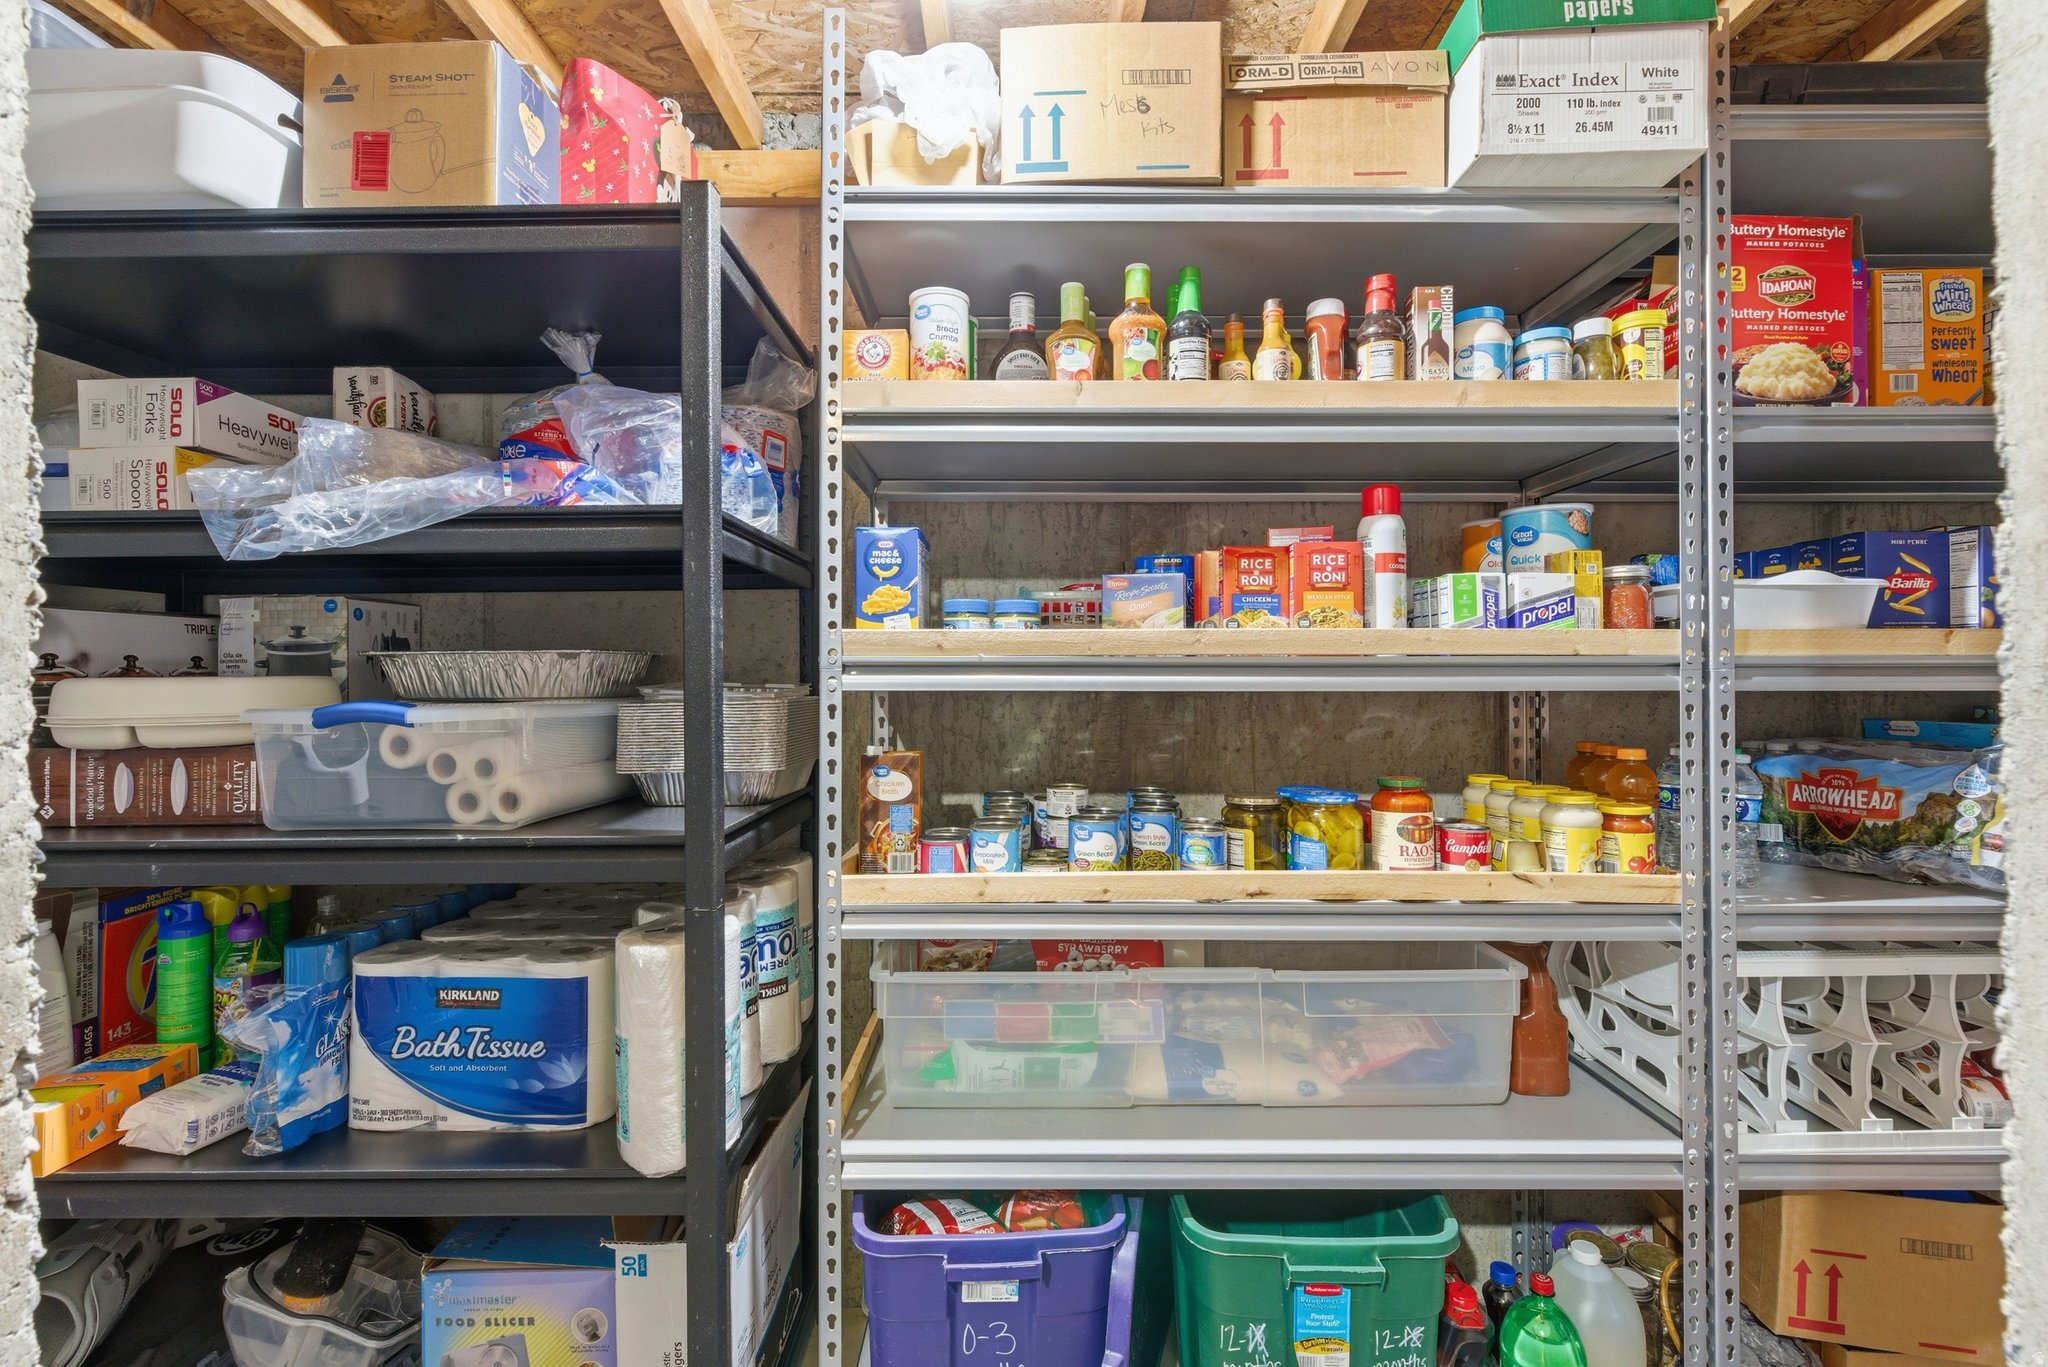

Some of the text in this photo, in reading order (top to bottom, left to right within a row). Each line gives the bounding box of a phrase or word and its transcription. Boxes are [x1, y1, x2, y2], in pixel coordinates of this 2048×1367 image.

[1563, 0, 1634, 22] papers
[1235, 67, 1290, 78] ORM-D
[1303, 65, 1358, 76] ORM-D-AIR
[1641, 67, 1680, 79] White
[389, 73, 432, 83] STEAM
[1572, 72, 1619, 87] Index
[1516, 97, 1541, 108] 2000
[1566, 97, 1621, 109] 110 lb. Index
[1141, 117, 1175, 138] Kits
[1533, 123, 1545, 136] 11
[1575, 121, 1614, 134] 26.45M
[1641, 125, 1679, 136] 49411
[1777, 223, 1848, 240] Homestyle
[1746, 240, 1825, 249] MASHED POTATOES
[1731, 267, 1742, 282] 2
[1761, 279, 1813, 294] IDAHOAN
[1937, 289, 1969, 302] Mini
[1933, 300, 1972, 313] Wheats
[1776, 308, 1848, 323] Homestyle
[936, 324, 959, 334] Bread
[1746, 324, 1825, 333] MASHED POTATOES
[1932, 327, 1977, 339] Perfectly
[929, 333, 959, 343] Crumbs
[1931, 337, 1977, 350] sweet
[116, 403, 125, 424] 500
[145, 393, 158, 434] Forks
[158, 384, 168, 441] Heavyweight
[170, 387, 183, 438] SOLO
[102, 478, 111, 500] 500
[129, 459, 143, 509] Spoon
[156, 461, 169, 511] SOLO
[1512, 530, 1533, 540] Great
[1240, 558, 1272, 570] RICE
[1313, 554, 1345, 566] RICE
[1511, 554, 1542, 565] Quick
[1241, 574, 1272, 586] RONI
[1313, 571, 1346, 583] RONI
[1890, 578, 1931, 589] Barilla
[1108, 580, 1128, 588] Lipton
[1129, 600, 1153, 611] Onion
[1488, 591, 1498, 630] propel
[1522, 597, 1571, 628] propel
[184, 623, 217, 635] TRIPLE
[233, 759, 247, 813] QUALITY
[1791, 784, 1896, 811] ARROWHEAD
[124, 897, 173, 914] BRIGHTENING
[1057, 943, 1129, 955] STRAWBERRY
[439, 990, 500, 1001] KIRKLAND
[107, 1022, 132, 1042] 143
[84, 1025, 93, 1055] BAGS
[391, 1025, 547, 1060] Bath Tissue
[430, 1064, 508, 1072] Soft and Absorbent
[622, 1256, 637, 1276] 50
[435, 1316, 536, 1328] FOOD SLICER
[1310, 1312, 1335, 1320] Protect
[1305, 1319, 1321, 1327] Your
[962, 1321, 1017, 1355] 0-3
[663, 1351, 671, 1367] stic
[674, 1342, 683, 1367] gers
